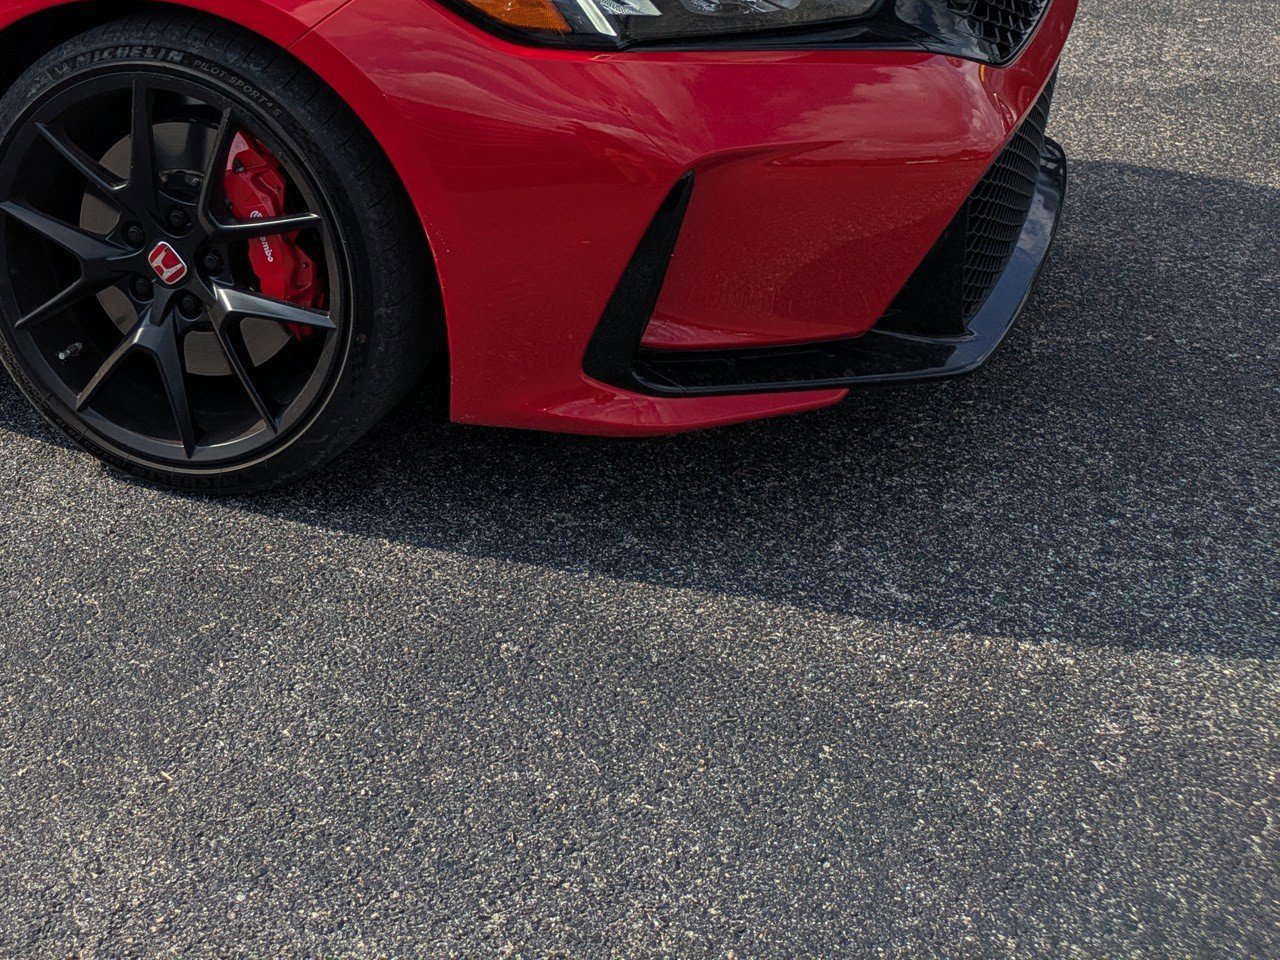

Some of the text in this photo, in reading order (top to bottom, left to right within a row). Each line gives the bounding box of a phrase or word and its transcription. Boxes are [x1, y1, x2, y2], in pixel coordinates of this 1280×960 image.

[76, 46, 185, 68] MICHELIN
[193, 58, 227, 81] PILOT
[228, 74, 268, 105] SPORT
[260, 235, 274, 263] embo
